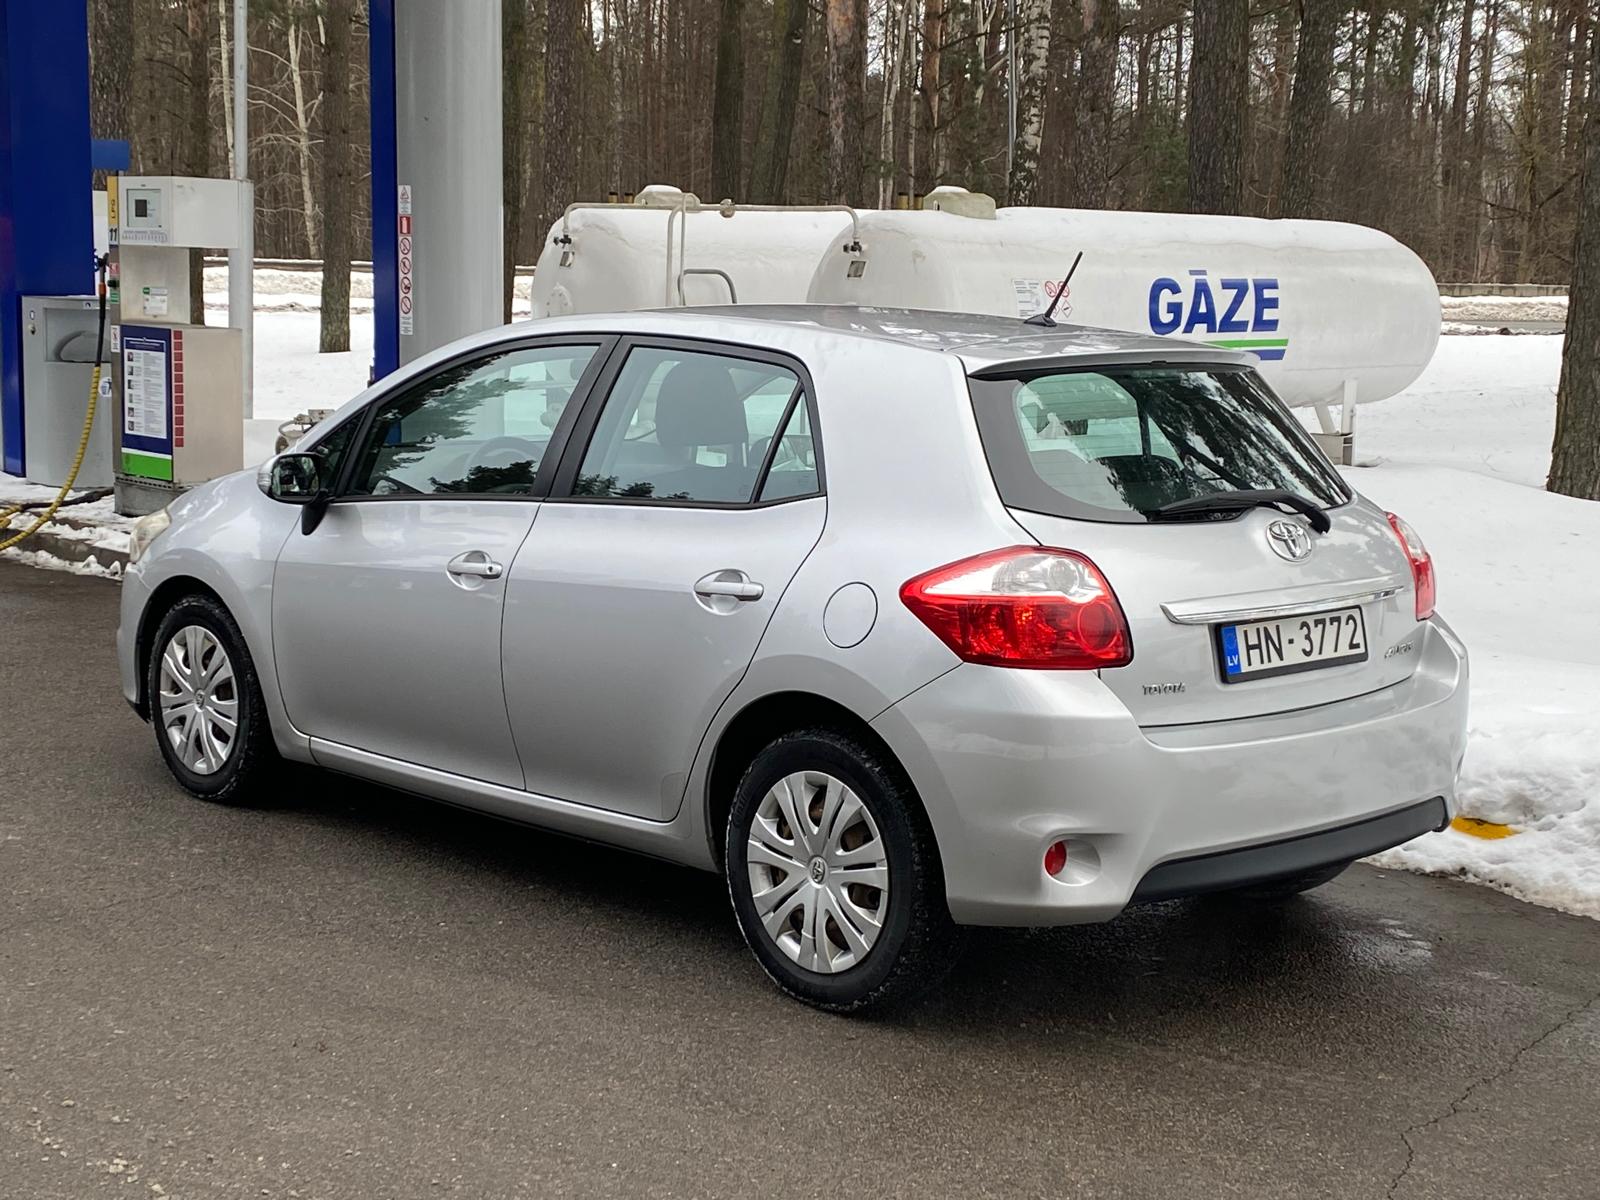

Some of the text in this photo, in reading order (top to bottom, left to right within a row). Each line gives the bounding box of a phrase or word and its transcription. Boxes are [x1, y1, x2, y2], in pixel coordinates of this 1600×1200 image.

[109, 227, 118, 242] 11
[1149, 269, 1279, 336] GĀZE
[1244, 614, 1361, 667] HN-3772
[1227, 654, 1239, 667] LV
